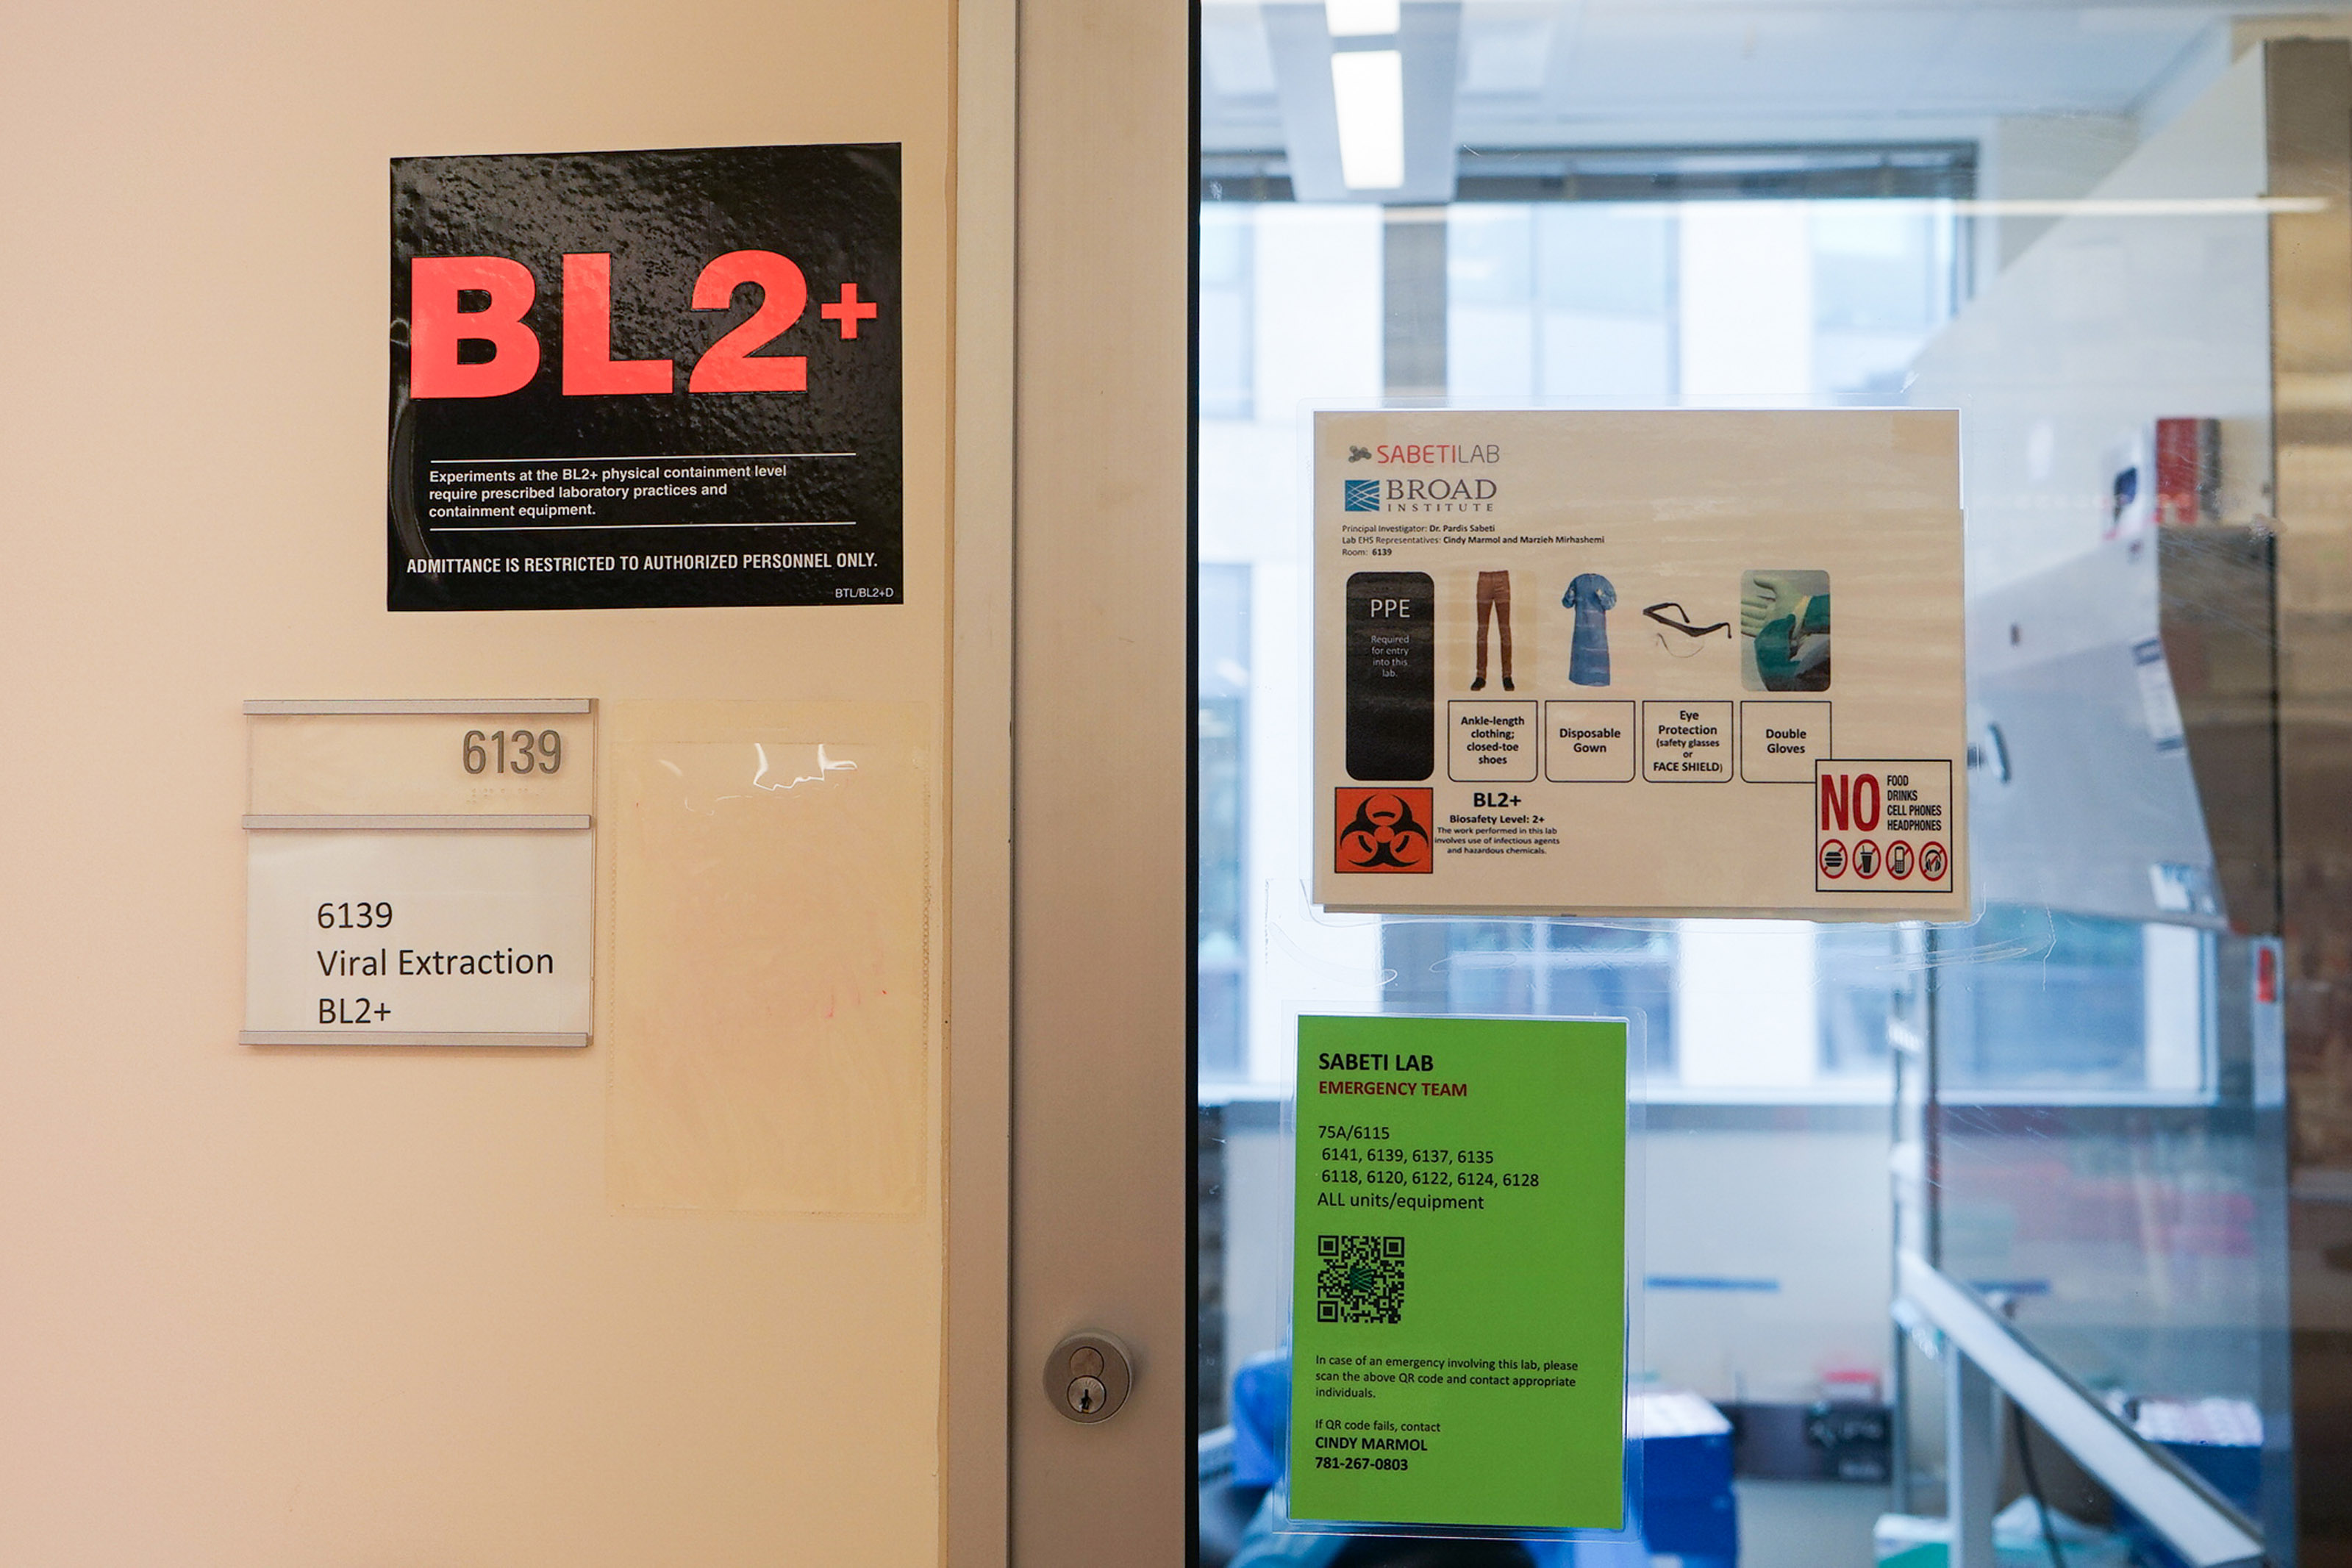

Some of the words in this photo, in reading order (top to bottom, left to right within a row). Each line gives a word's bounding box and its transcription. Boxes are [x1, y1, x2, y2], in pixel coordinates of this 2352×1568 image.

[410, 249, 878, 399] BL2+
[429, 470, 516, 485] Experiments
[519, 469, 533, 482] at
[536, 469, 559, 482] the
[562, 468, 598, 480] BL2+
[602, 466, 660, 482] physical
[663, 465, 751, 479] containment
[754, 465, 787, 477] level
[429, 487, 478, 503] require
[481, 486, 554, 502] prescribed
[559, 486, 629, 500] laboratory
[633, 484, 698, 500] practices
[701, 483, 727, 495] and
[1386, 479, 1497, 500] BROAD
[429, 505, 515, 518] containment
[518, 504, 596, 519] equipment.
[1387, 503, 1493, 512] INSTITUTE
[1342, 524, 1377, 534] Principal
[1378, 525, 1427, 534] Investigator:
[1429, 524, 1441, 532] Dr.
[1443, 524, 1468, 532] Pardis
[1469, 524, 1495, 533] Sabeti
[1342, 536, 1356, 545] Lab
[1358, 536, 1374, 545] EHS
[1376, 536, 1441, 545] Representatives:
[1443, 536, 1467, 545] Cindy
[1468, 536, 1501, 544] Marmol
[1502, 535, 1518, 544] and
[1520, 535, 1554, 544] Marzieh
[1555, 535, 1605, 544] Mirhashemi
[1342, 548, 1368, 556] Room:
[1371, 548, 1393, 556] 6139
[407, 558, 501, 573] ADMITTANCE
[505, 557, 520, 573] IS
[524, 556, 615, 572] RESTRICTED
[619, 555, 639, 570] TO
[643, 554, 738, 570] AUTHORIZED
[743, 553, 832, 569] PERSONNEL
[837, 552, 878, 568] ONLY.
[835, 587, 894, 598] BTL/BL2+D
[1370, 599, 1410, 618] PPE
[1370, 634, 1409, 645] Required
[1371, 645, 1384, 655] for
[1385, 647, 1409, 656] entry
[1373, 659, 1390, 667] into
[1391, 657, 1408, 667] this
[1381, 668, 1398, 678] lab.
[1460, 715, 1525, 728] Ankle-length
[1679, 710, 1700, 723] Eye
[1470, 728, 1515, 741] clothing;
[1559, 728, 1621, 740] Disposable
[1658, 724, 1717, 735] Protection
[1765, 728, 1807, 740] Double
[1466, 742, 1519, 752] closed-toe
[1573, 742, 1607, 753] Gown
[1656, 738, 1687, 749] (safety
[1688, 738, 1720, 749] glasses
[1767, 742, 1806, 754] Gloves
[462, 729, 562, 775] 6139
[1478, 754, 1508, 765] shoes
[1653, 762, 1679, 772] FACE
[1681, 762, 1723, 773] SHIELD)
[1887, 774, 1909, 787] FOOD
[1473, 792, 1522, 808] BL2+
[1887, 790, 1918, 801] DRINKS
[1821, 773, 1881, 832] NO
[1887, 804, 1907, 816] CELL
[1909, 804, 1942, 817] PHONES
[1449, 814, 1498, 826] Biosafety
[1499, 815, 1530, 824] Level:
[1532, 815, 1545, 824] 2+
[1887, 819, 1942, 831] HEADPHONES
[1437, 826, 1452, 834] The
[1475, 826, 1518, 835] performed
[1545, 827, 1558, 835] lab
[1434, 837, 1481, 845] involves
[1483, 837, 1493, 845] of
[1493, 837, 1532, 845] infectious
[1534, 838, 1560, 846] agents
[318, 901, 393, 929] 6139
[317, 948, 386, 976] Viral
[399, 947, 553, 975] Extraction
[319, 998, 391, 1024] BL2+
[1318, 1053, 1388, 1071] SABETI
[1395, 1054, 1434, 1072] LAB
[1319, 1081, 1418, 1096] EMERGENCY
[1420, 1082, 1468, 1097] TEAM
[1318, 1125, 1390, 1142] 75A/6115
[1322, 1148, 1362, 1164] 6141,
[1367, 1148, 1408, 1164] 6139,
[1412, 1149, 1453, 1165] 6137,
[1457, 1150, 1494, 1164] 6135
[1321, 1169, 1362, 1186] 6118,
[1367, 1170, 1407, 1186] 6120,
[1412, 1171, 1453, 1187] 6122,
[1457, 1172, 1498, 1189] 6124,
[1503, 1173, 1540, 1187] 6128
[1317, 1192, 1345, 1207] ALL
[1350, 1192, 1484, 1212] units/equipment
[1315, 1355, 1326, 1364] In
[1329, 1357, 1353, 1366] case
[1355, 1355, 1368, 1366] of
[1369, 1358, 1383, 1366] an
[1385, 1358, 1445, 1370] emergency
[1448, 1358, 1496, 1372] involving
[1498, 1358, 1518, 1370] this
[1520, 1359, 1540, 1372] lab,
[1543, 1360, 1579, 1372] please
[1315, 1372, 1340, 1381] scan
[1342, 1371, 1360, 1382] the
[1363, 1372, 1396, 1383] above
[1398, 1372, 1415, 1384] QR
[1418, 1373, 1444, 1384] code
[1446, 1374, 1467, 1384] and
[1469, 1375, 1510, 1386] contact
[1512, 1376, 1576, 1389] appropriate
[1315, 1386, 1376, 1398] individuals.
[1315, 1419, 1323, 1429] If
[1325, 1419, 1342, 1431] QR
[1344, 1420, 1370, 1431] code
[1373, 1420, 1398, 1433] fails,
[1400, 1422, 1441, 1433] contact
[1315, 1436, 1358, 1450] CINDY
[1361, 1437, 1428, 1451] MARMOL
[1315, 1456, 1409, 1471] 781-267-0803
